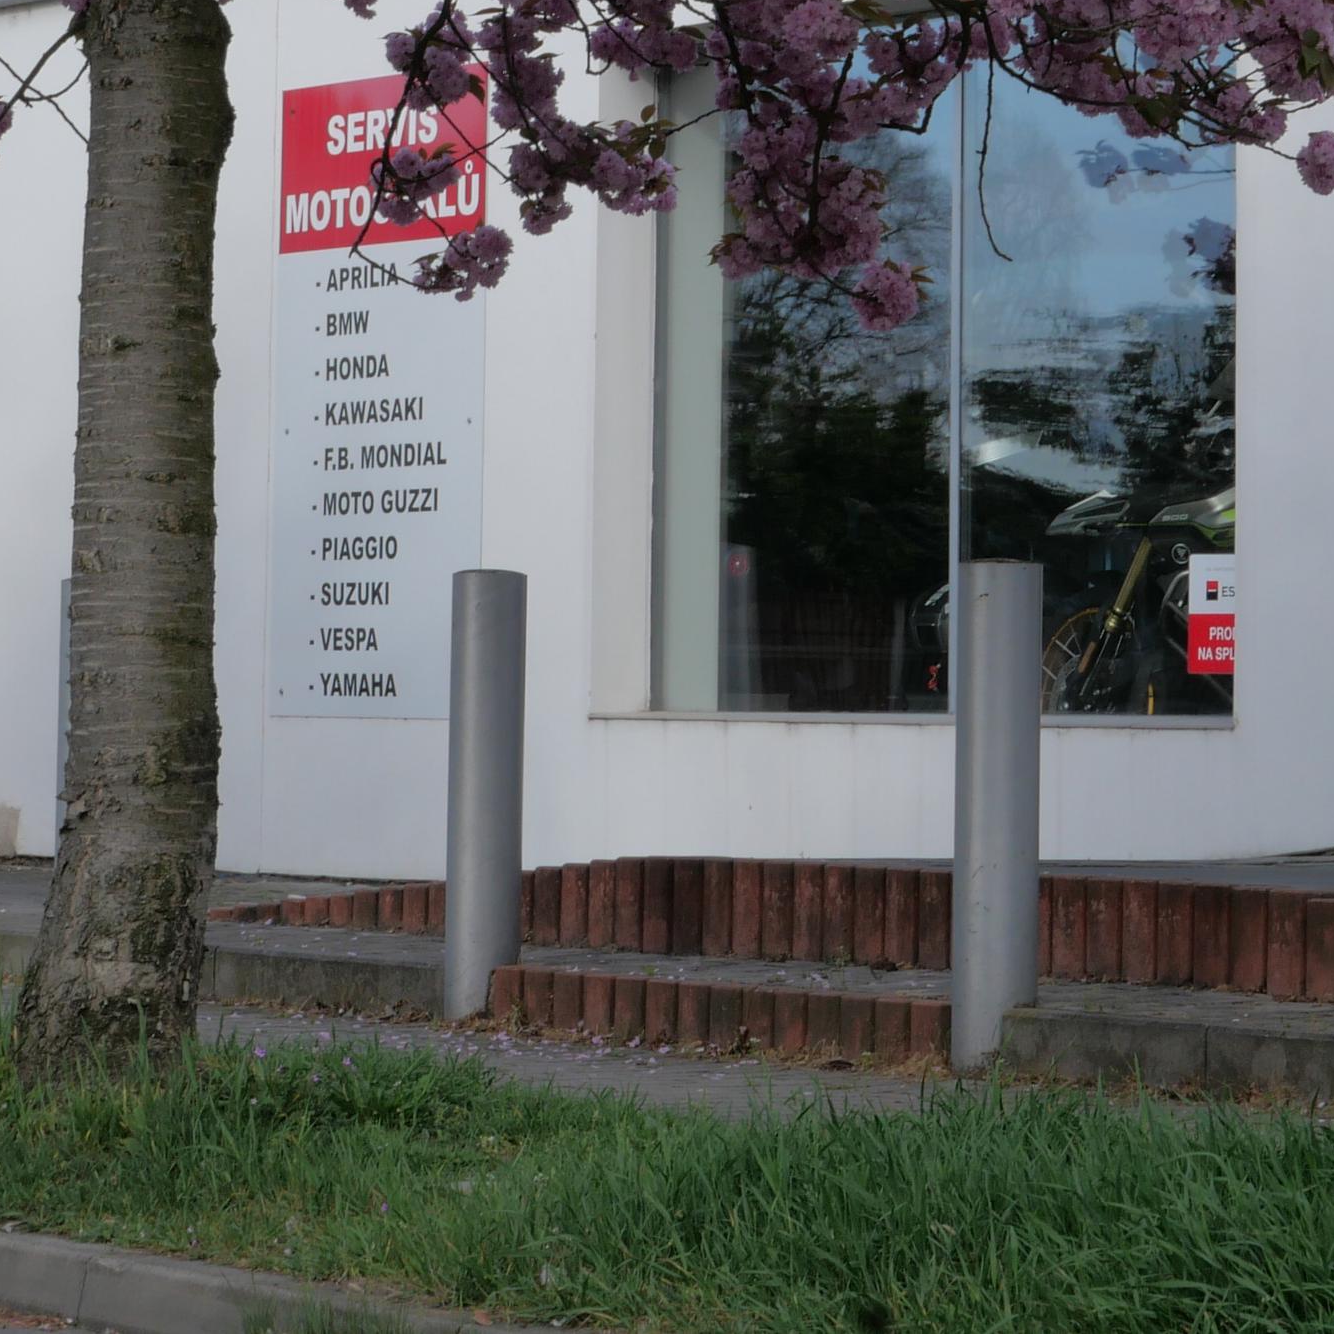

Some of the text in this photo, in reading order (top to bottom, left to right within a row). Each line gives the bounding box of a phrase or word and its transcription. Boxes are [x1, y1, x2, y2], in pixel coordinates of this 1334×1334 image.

[327, 105, 438, 155] SERVIS
[285, 160, 480, 234] MOTOLŮ
[326, 262, 398, 292] APRILIA
[326, 310, 369, 336] BMW
[325, 353, 389, 381] HONDA
[324, 396, 424, 426] KAWASAKI
[323, 441, 447, 471] F.B. MONDIAL
[322, 488, 439, 516] MOTO GUZZI
[322, 535, 398, 562] PIAGGIO
[320, 581, 390, 607] SUZUKI
[320, 628, 378, 652] VESPA
[1198, 647, 1213, 660] NA
[319, 672, 397, 697] YAMAHA
